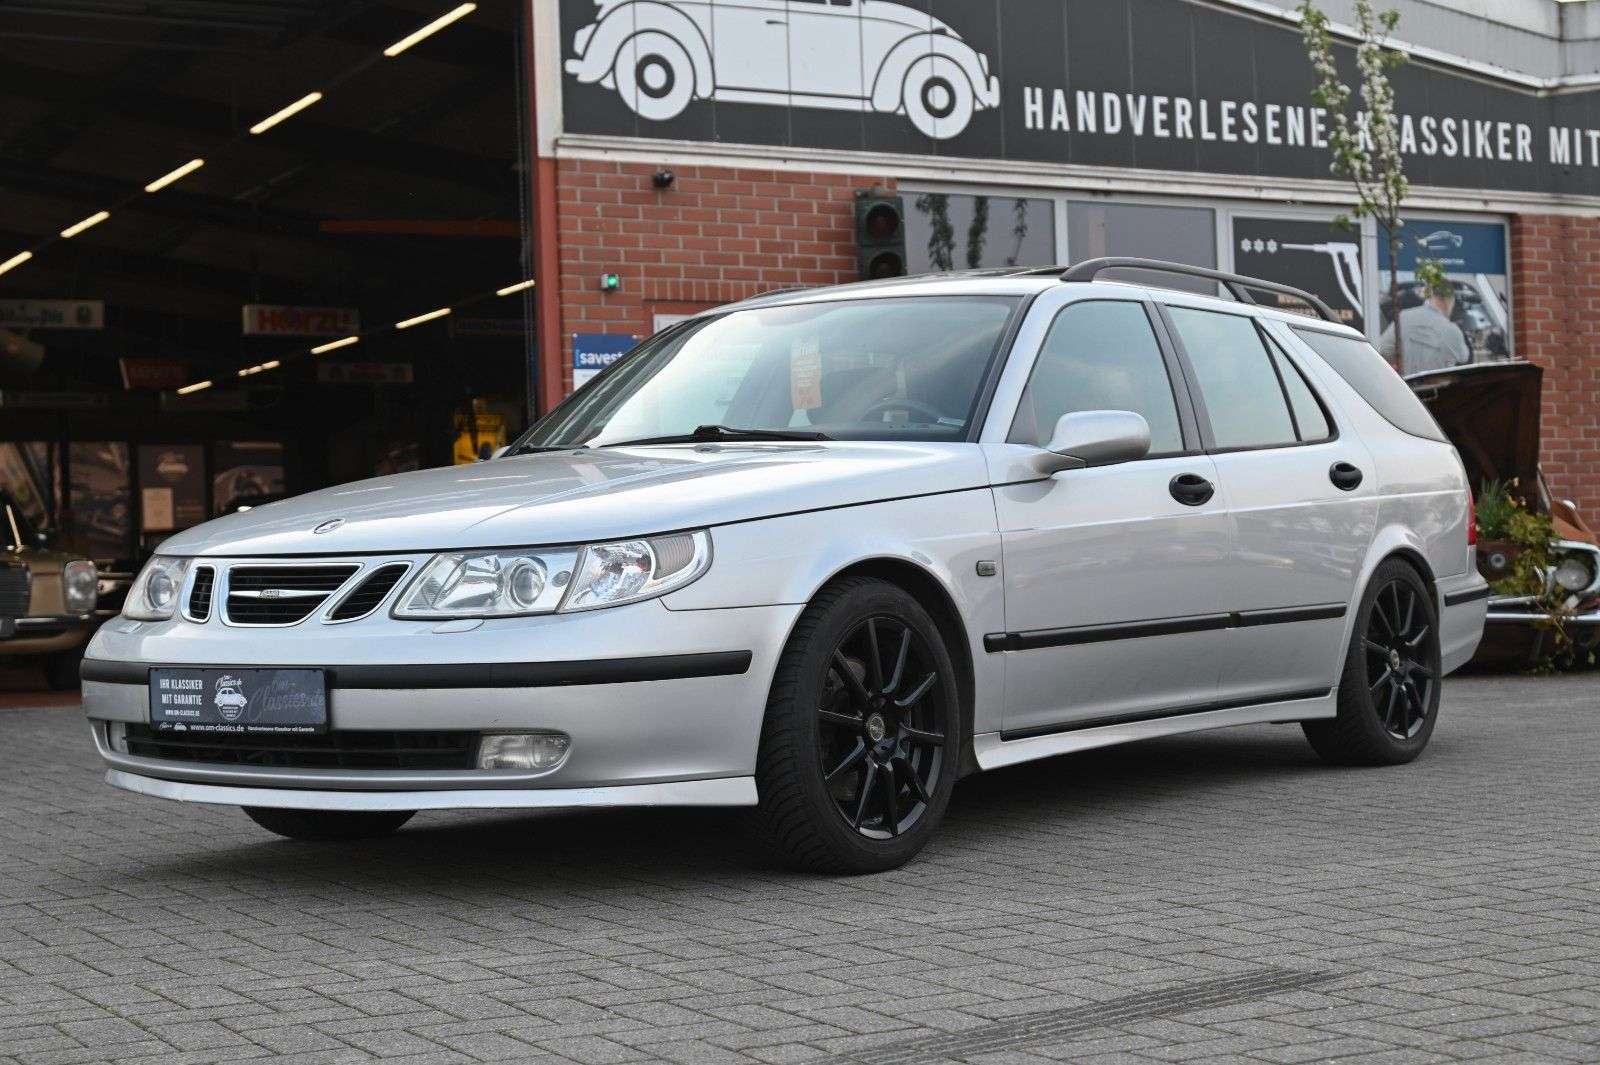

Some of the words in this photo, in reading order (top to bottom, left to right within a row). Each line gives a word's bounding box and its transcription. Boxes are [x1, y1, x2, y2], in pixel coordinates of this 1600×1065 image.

[1022, 86, 1328, 149] HANDVERLESENE
[1356, 110, 1534, 162] KASSIKER
[1549, 126, 1600, 167] MIT
[171, 679, 203, 690] KLASSIKER
[161, 693, 172, 704] MIT
[173, 694, 203, 705] GARANTIE
